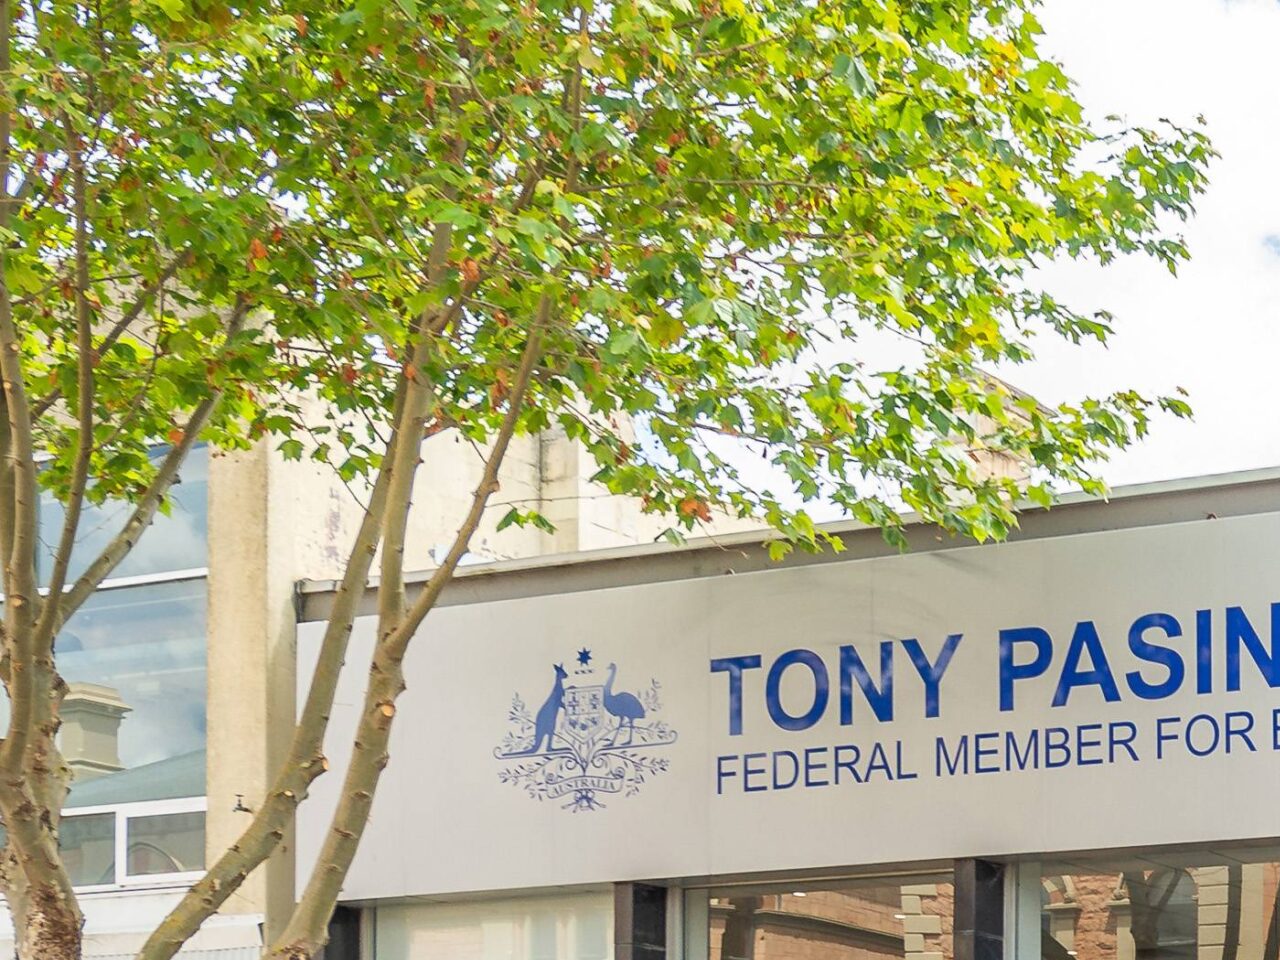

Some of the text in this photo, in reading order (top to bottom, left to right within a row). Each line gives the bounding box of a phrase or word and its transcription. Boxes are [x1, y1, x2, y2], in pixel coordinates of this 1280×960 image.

[711, 636, 962, 735] TONY
[552, 777, 616, 796] AUSTRALIA
[715, 740, 918, 795] FEDERAL
[934, 721, 1139, 777] MEMBER
[1155, 711, 1257, 760] FOR
